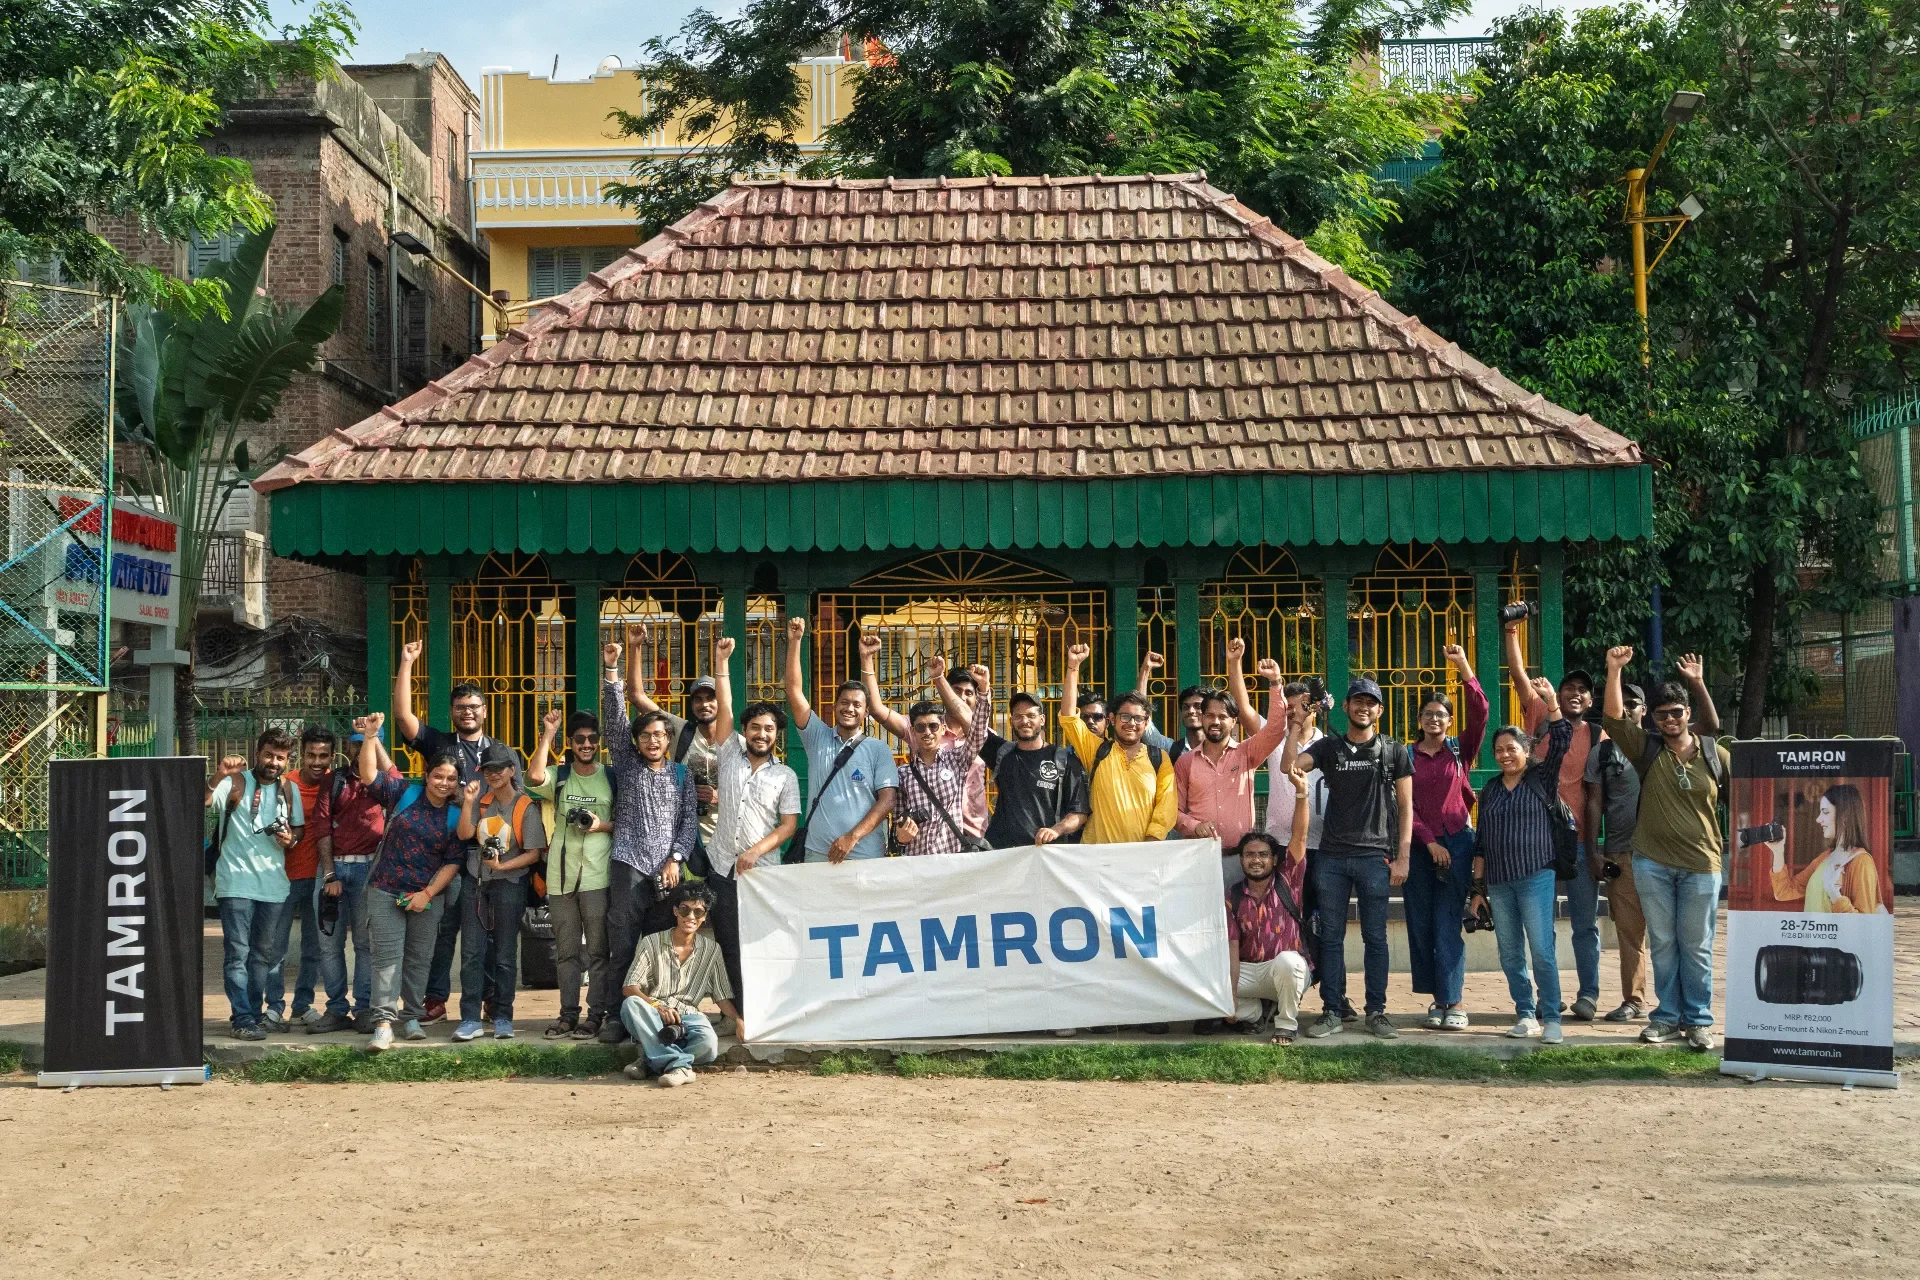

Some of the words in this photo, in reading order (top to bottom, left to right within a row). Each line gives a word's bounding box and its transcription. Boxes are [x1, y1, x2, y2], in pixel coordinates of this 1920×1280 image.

[138, 558, 171, 596] GYM
[1777, 750, 1845, 762] TAMRON
[105, 789, 146, 1036] TAMRON
[1781, 920, 1838, 931] 28-75mm
[808, 905, 1158, 980] TAMRON
[1785, 1013, 1802, 1021] MRP:
[1760, 1024, 1776, 1032] Sony
[1778, 1025, 1807, 1033] E-mount
[1816, 1027, 1837, 1035] Nikon
[1838, 1028, 1868, 1036] Z-mount
[1773, 1047, 1842, 1058] www.tamron.in
